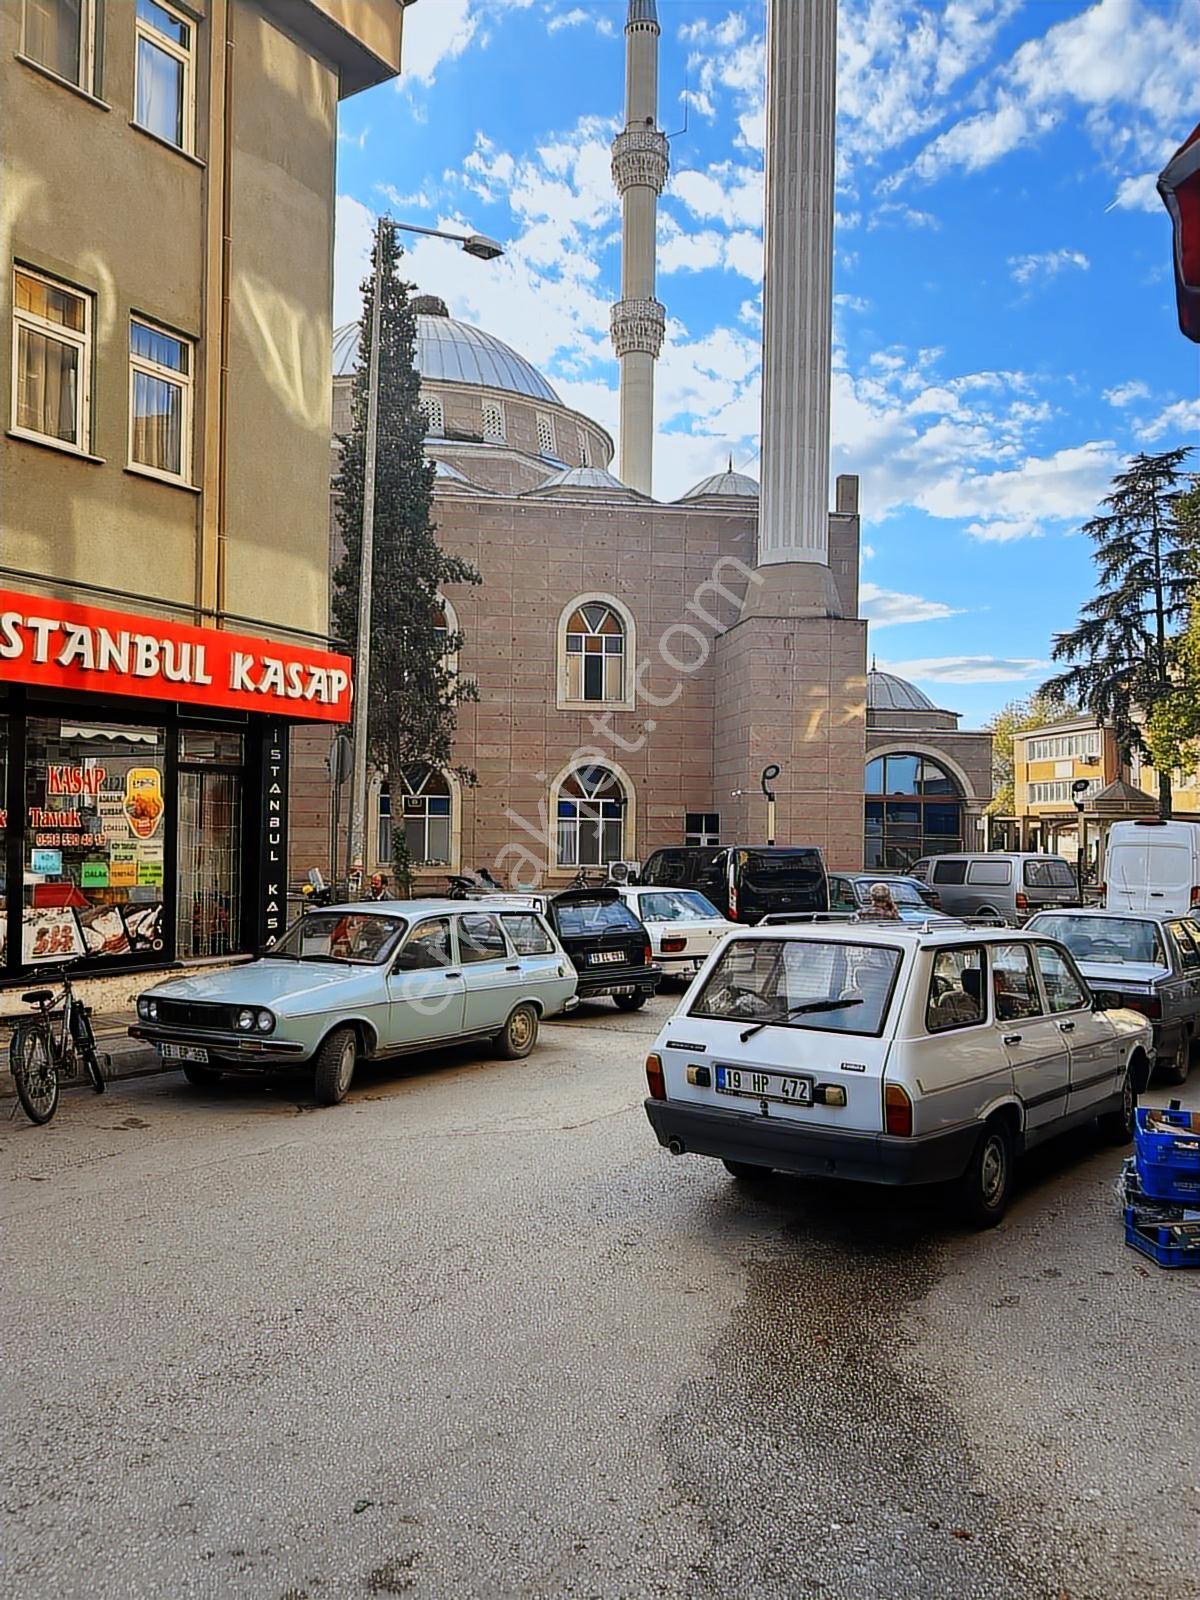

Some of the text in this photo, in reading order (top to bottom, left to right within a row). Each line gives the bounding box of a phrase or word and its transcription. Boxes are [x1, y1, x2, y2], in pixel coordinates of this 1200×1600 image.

[230, 651, 348, 704] KASAP
[48, 765, 106, 795] KASAP
[29, 807, 82, 828] Tavuk
[266, 884, 279, 947] KASA
[726, 1070, 742, 1089] 19
[752, 1073, 770, 1093] HP
[781, 1077, 808, 1099] 472
